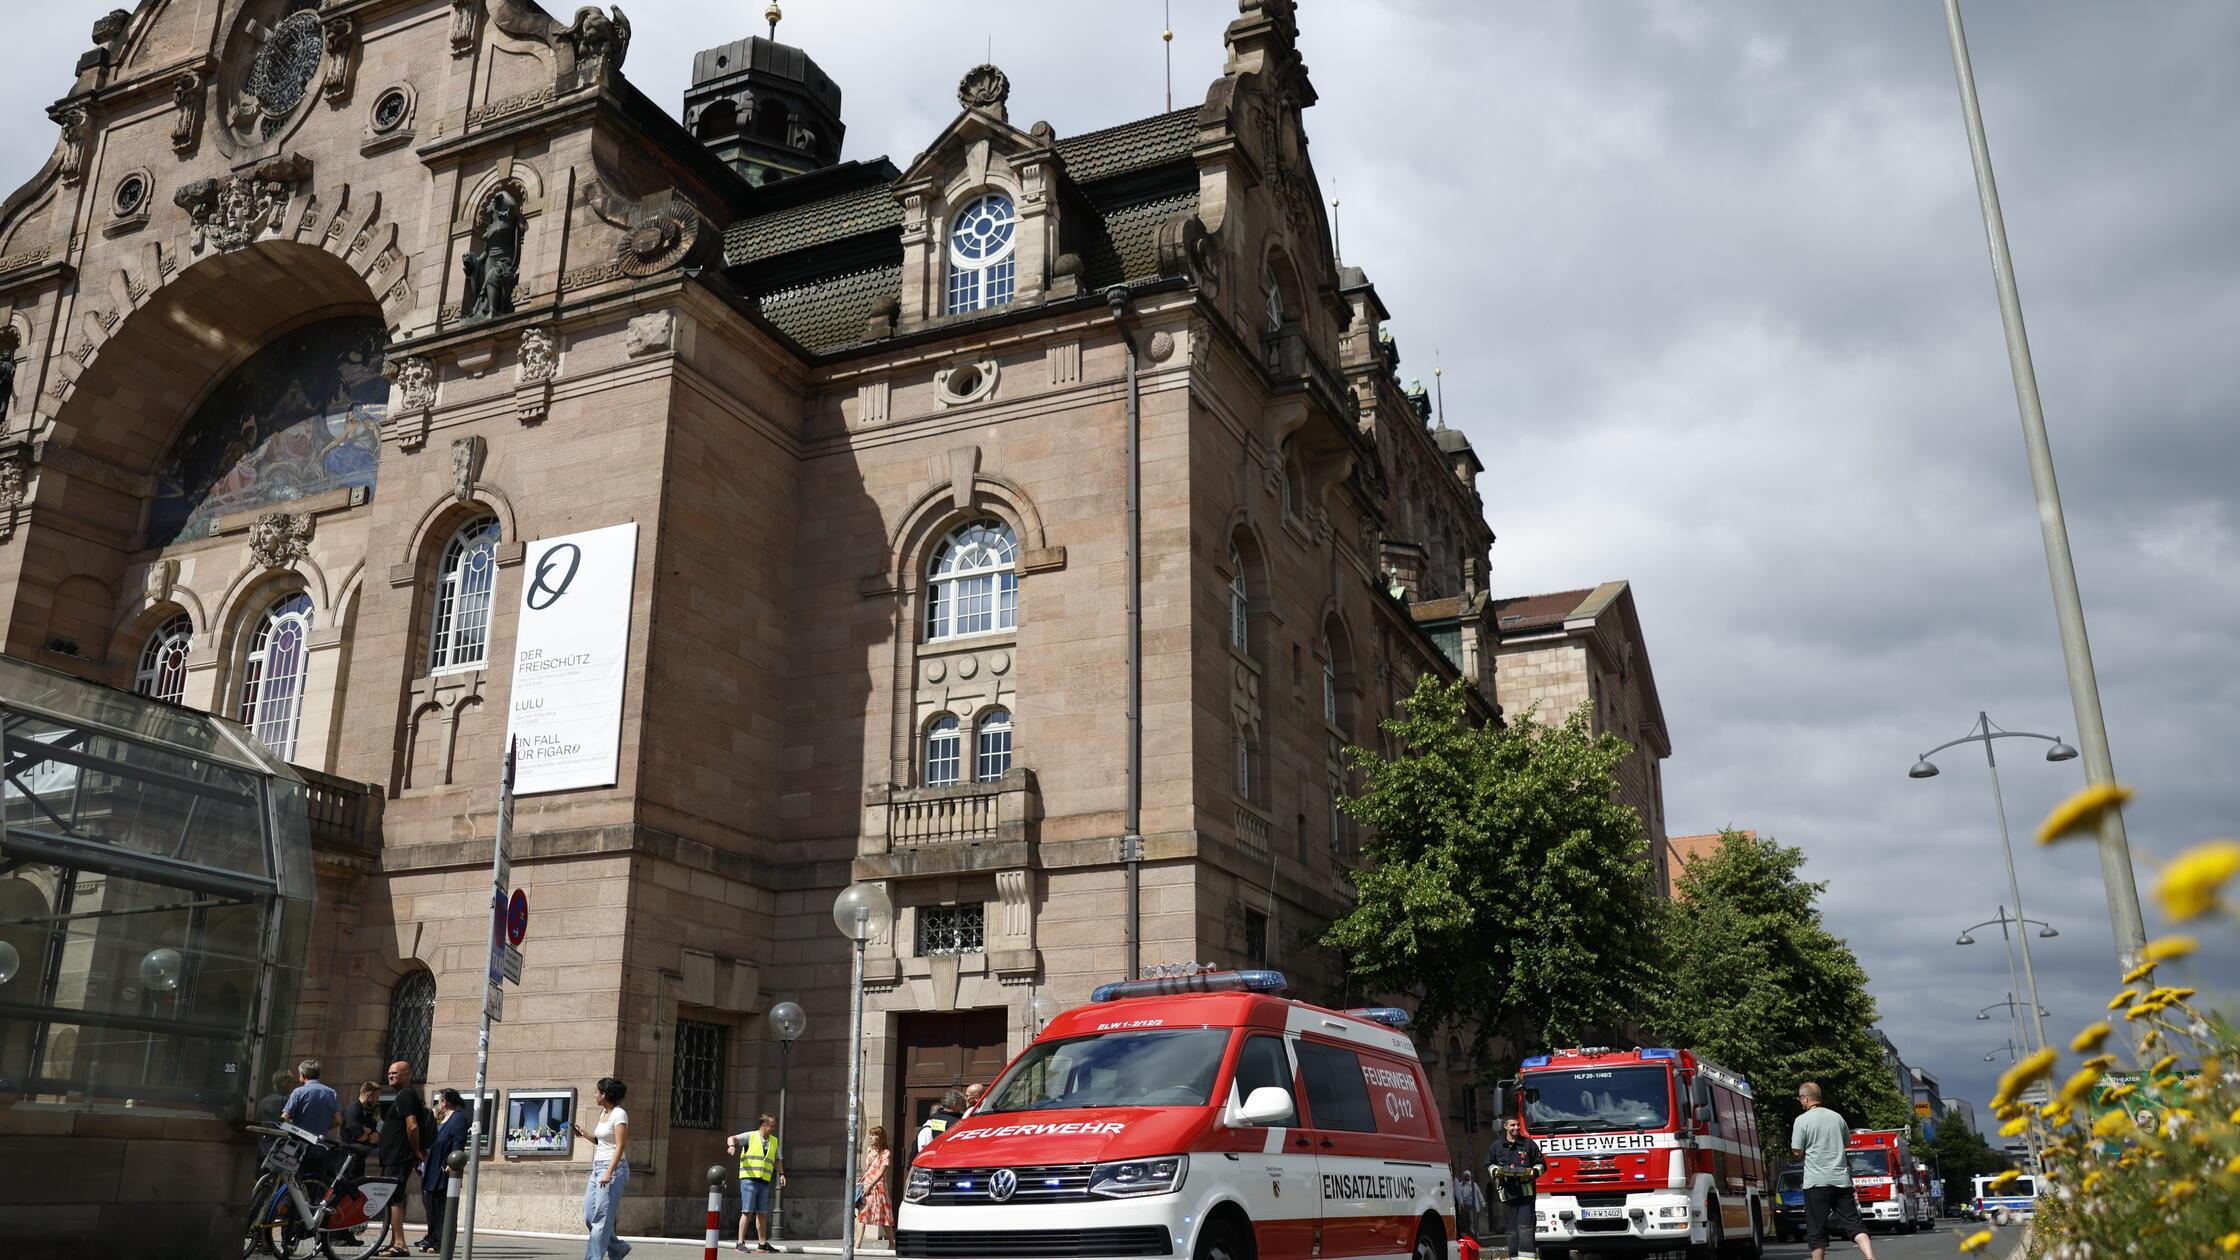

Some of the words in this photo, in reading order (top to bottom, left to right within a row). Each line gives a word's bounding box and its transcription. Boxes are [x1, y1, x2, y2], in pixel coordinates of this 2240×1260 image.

[519, 653, 590, 674] FREISCHÜTZ
[520, 648, 543, 662] DER
[515, 698, 544, 711] LULU
[534, 733, 560, 746] FALL
[1361, 1065, 1418, 1093] FEUERWEHR
[1398, 1098, 1415, 1119] 112
[946, 1122, 1126, 1142] FEUERWEHR
[1540, 1135, 1655, 1152] FEUERWEHR
[1322, 1174, 1416, 1200] EINSATZLEITUNG
